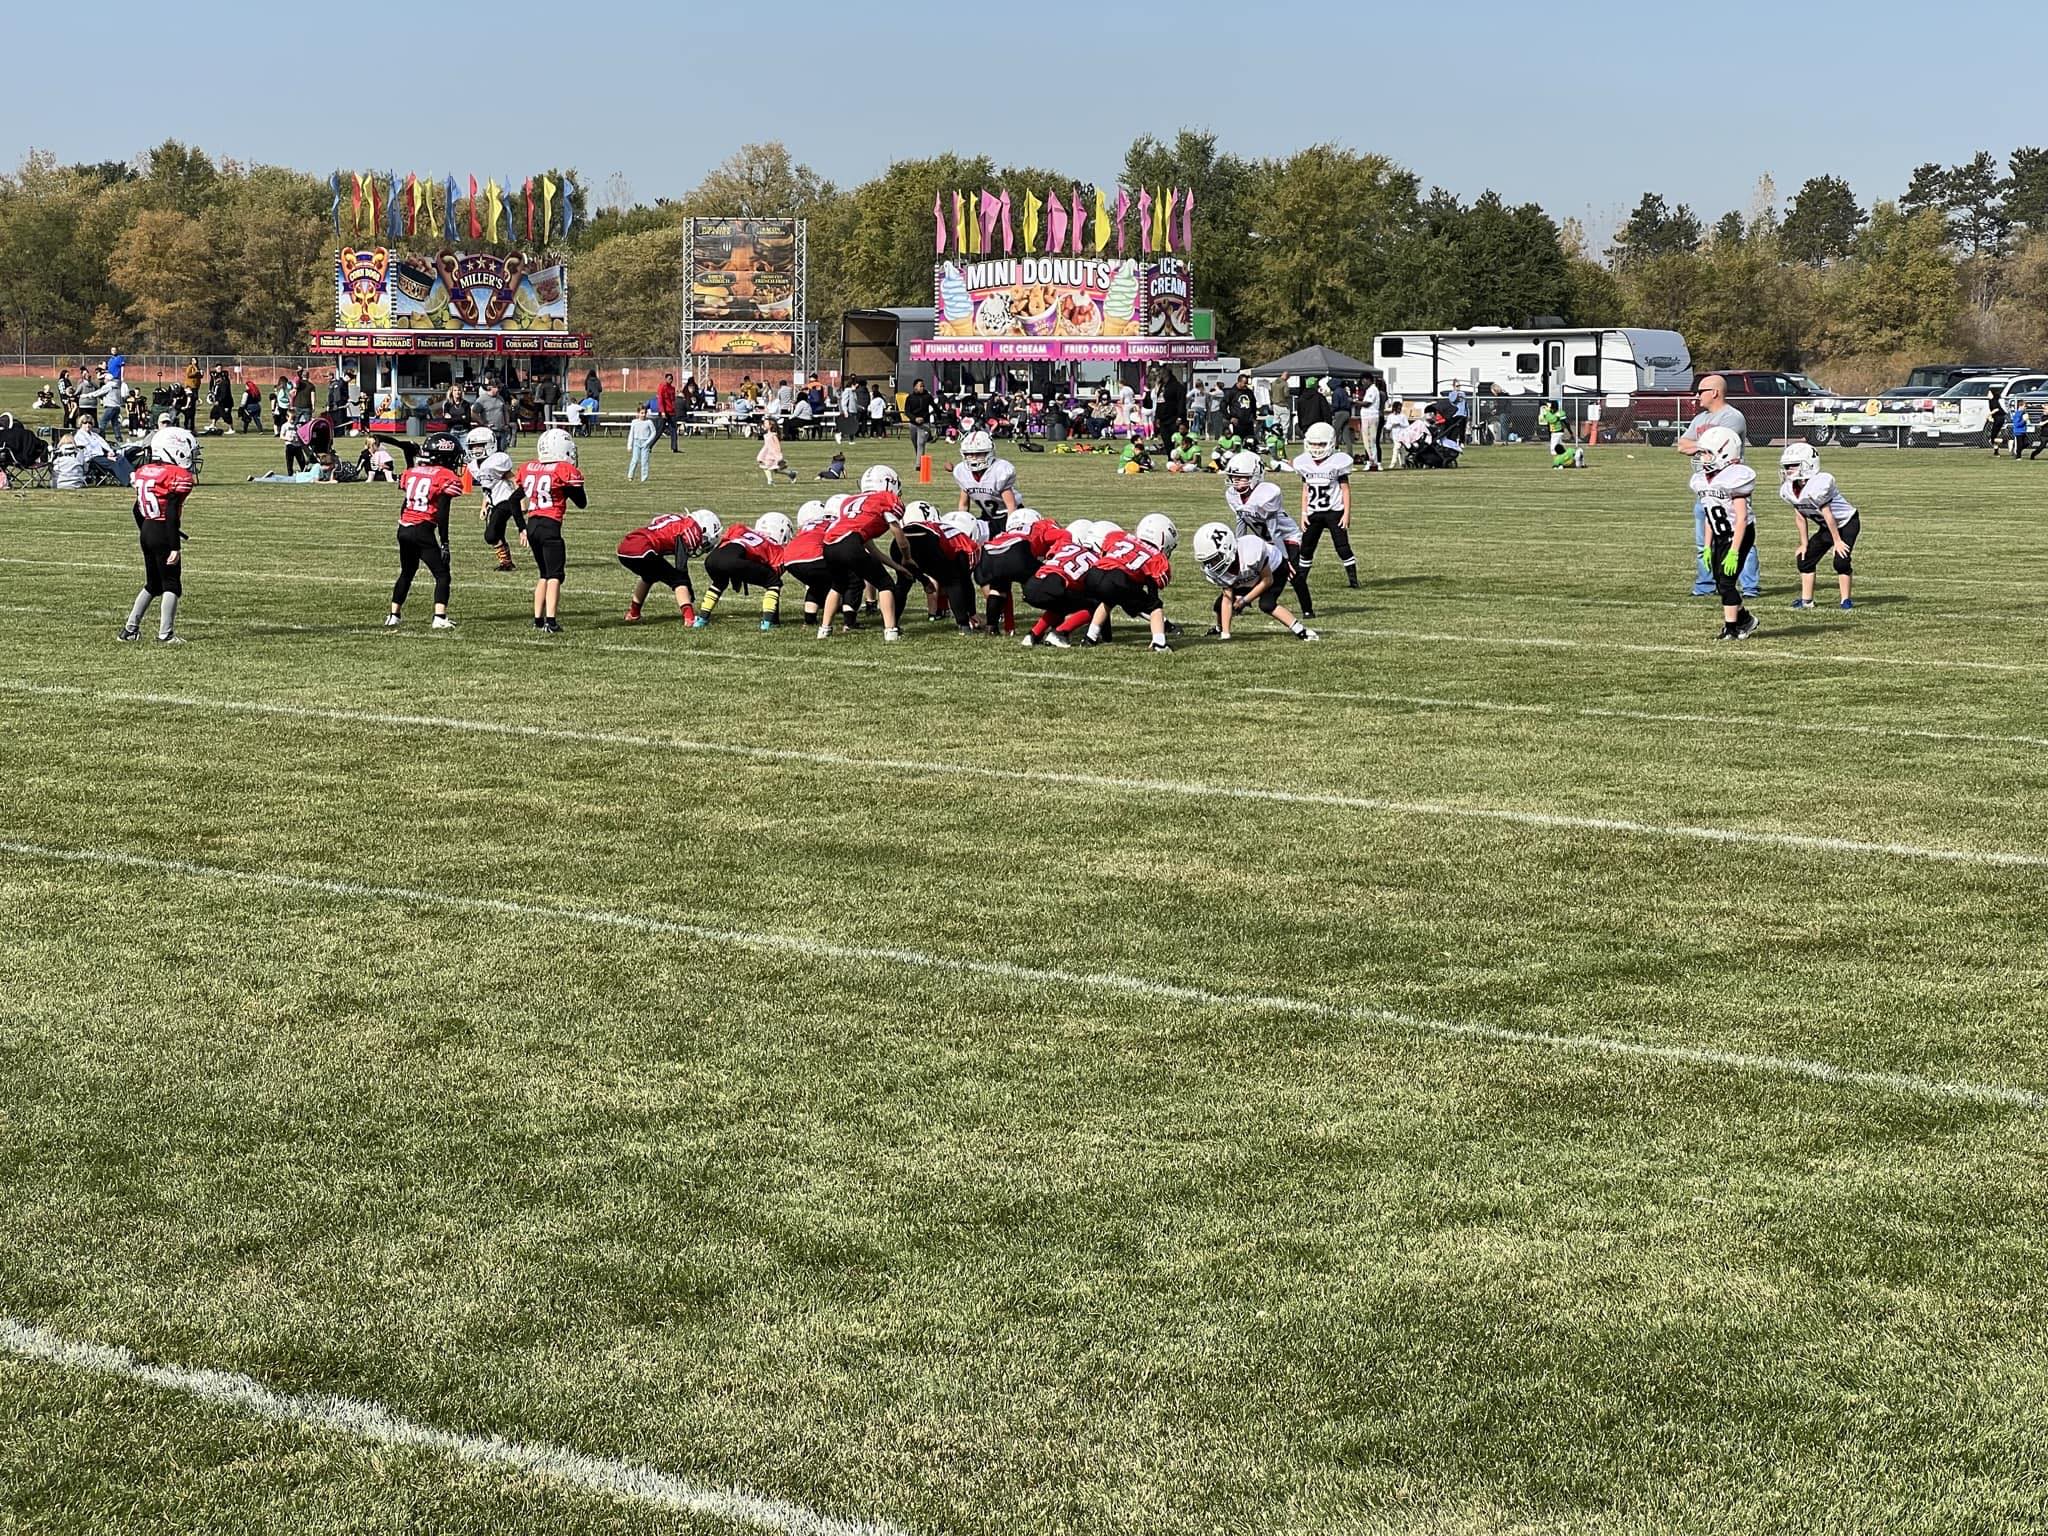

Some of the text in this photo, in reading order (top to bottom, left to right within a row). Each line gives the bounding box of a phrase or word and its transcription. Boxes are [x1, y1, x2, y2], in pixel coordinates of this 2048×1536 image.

[1159, 257, 1177, 275] ICE
[349, 268, 364, 282] CORN
[460, 272, 504, 290] MILLER'S
[966, 258, 1111, 291] MINI DONUTS
[1150, 276, 1187, 298] CREAM
[373, 338, 412, 348] LEMONADE
[460, 339, 494, 348] HOT DOGS
[505, 340, 538, 348] CORN DOGS
[925, 344, 984, 354] FUNNEL CAKES
[999, 344, 1048, 354] ICE CREAM
[1064, 345, 1121, 354] FRIED OREOS
[1128, 345, 1167, 354] LEMONADE
[1171, 345, 1210, 354] MINI DONUTS
[406, 475, 431, 512] 18
[523, 474, 553, 511] 28
[1308, 485, 1331, 510] 25
[1704, 505, 1734, 537] 18
